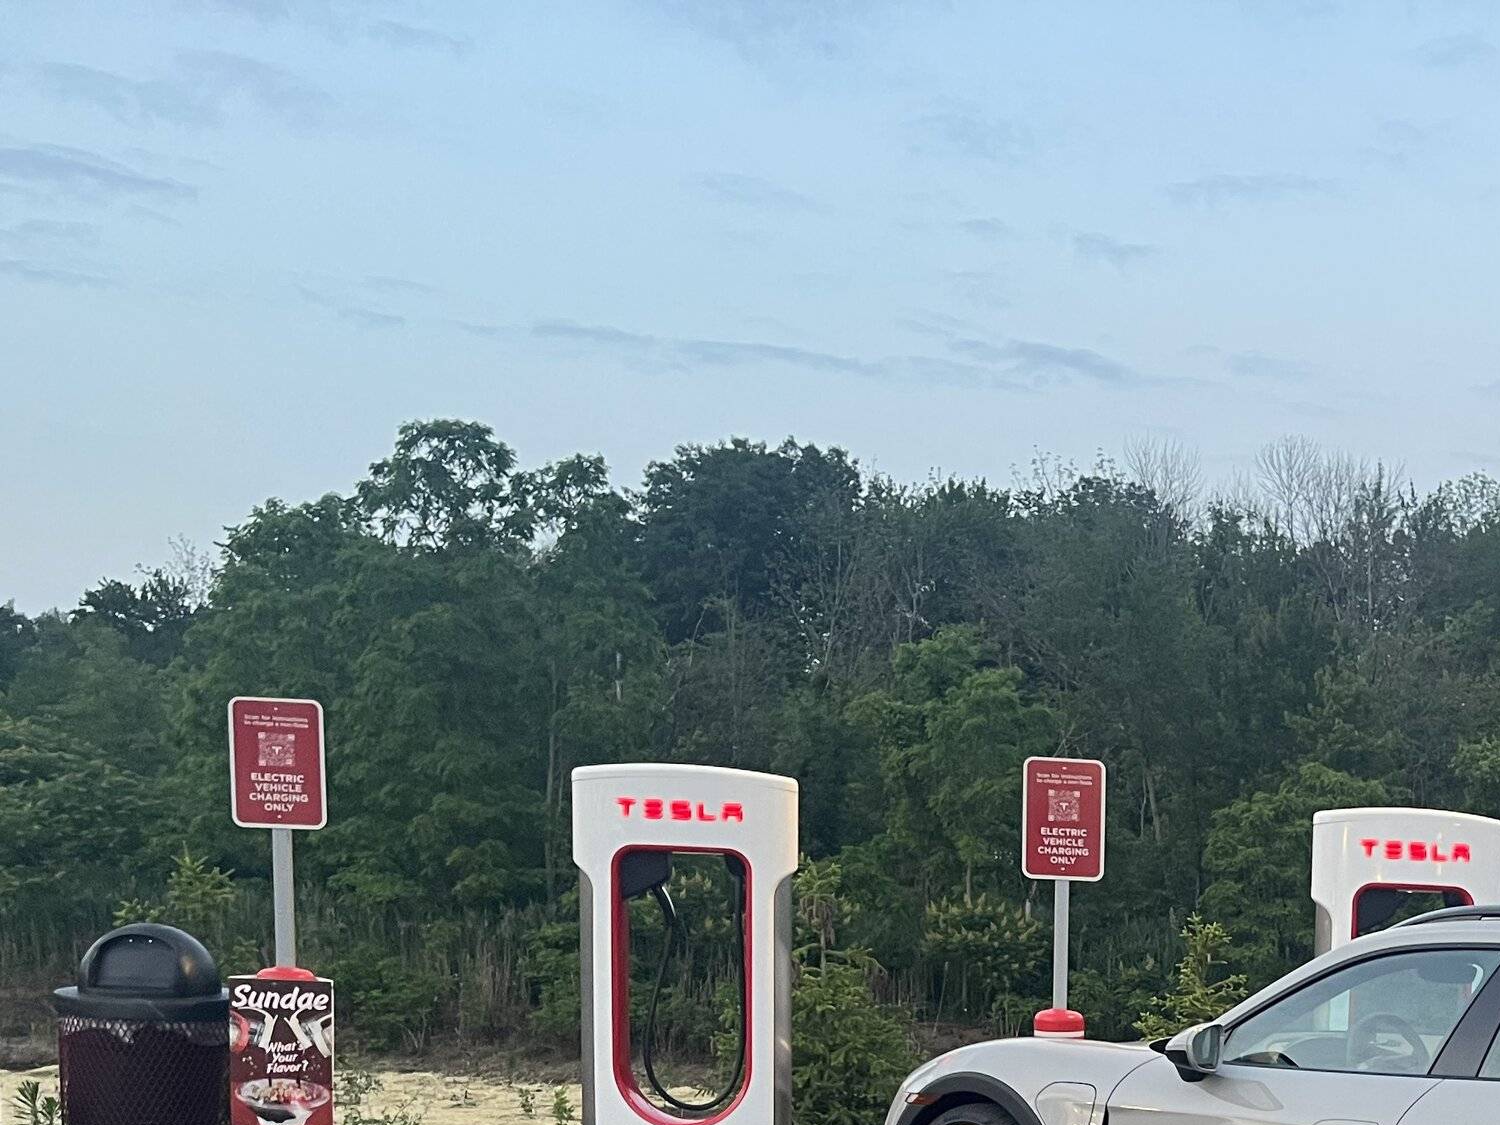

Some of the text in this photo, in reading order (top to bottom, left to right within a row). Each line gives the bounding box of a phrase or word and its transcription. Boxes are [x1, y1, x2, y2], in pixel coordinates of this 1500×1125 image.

[250, 772, 304, 783] ELECTRIC
[255, 782, 302, 792] VEHICLE
[249, 792, 309, 802] CHARGING
[264, 802, 294, 812] ONLY
[616, 797, 743, 822] TESLA
[1040, 826, 1088, 837] ELECTRIC
[1042, 837, 1084, 847] VEHICLE
[1038, 846, 1089, 856] CHARGING
[1360, 839, 1471, 863] TESLA
[1050, 856, 1076, 864] ONLY
[231, 984, 330, 1010] Sundae
[267, 1042, 305, 1052] What's
[272, 1052, 298, 1064] Your
[266, 1060, 308, 1074] Flavor?
